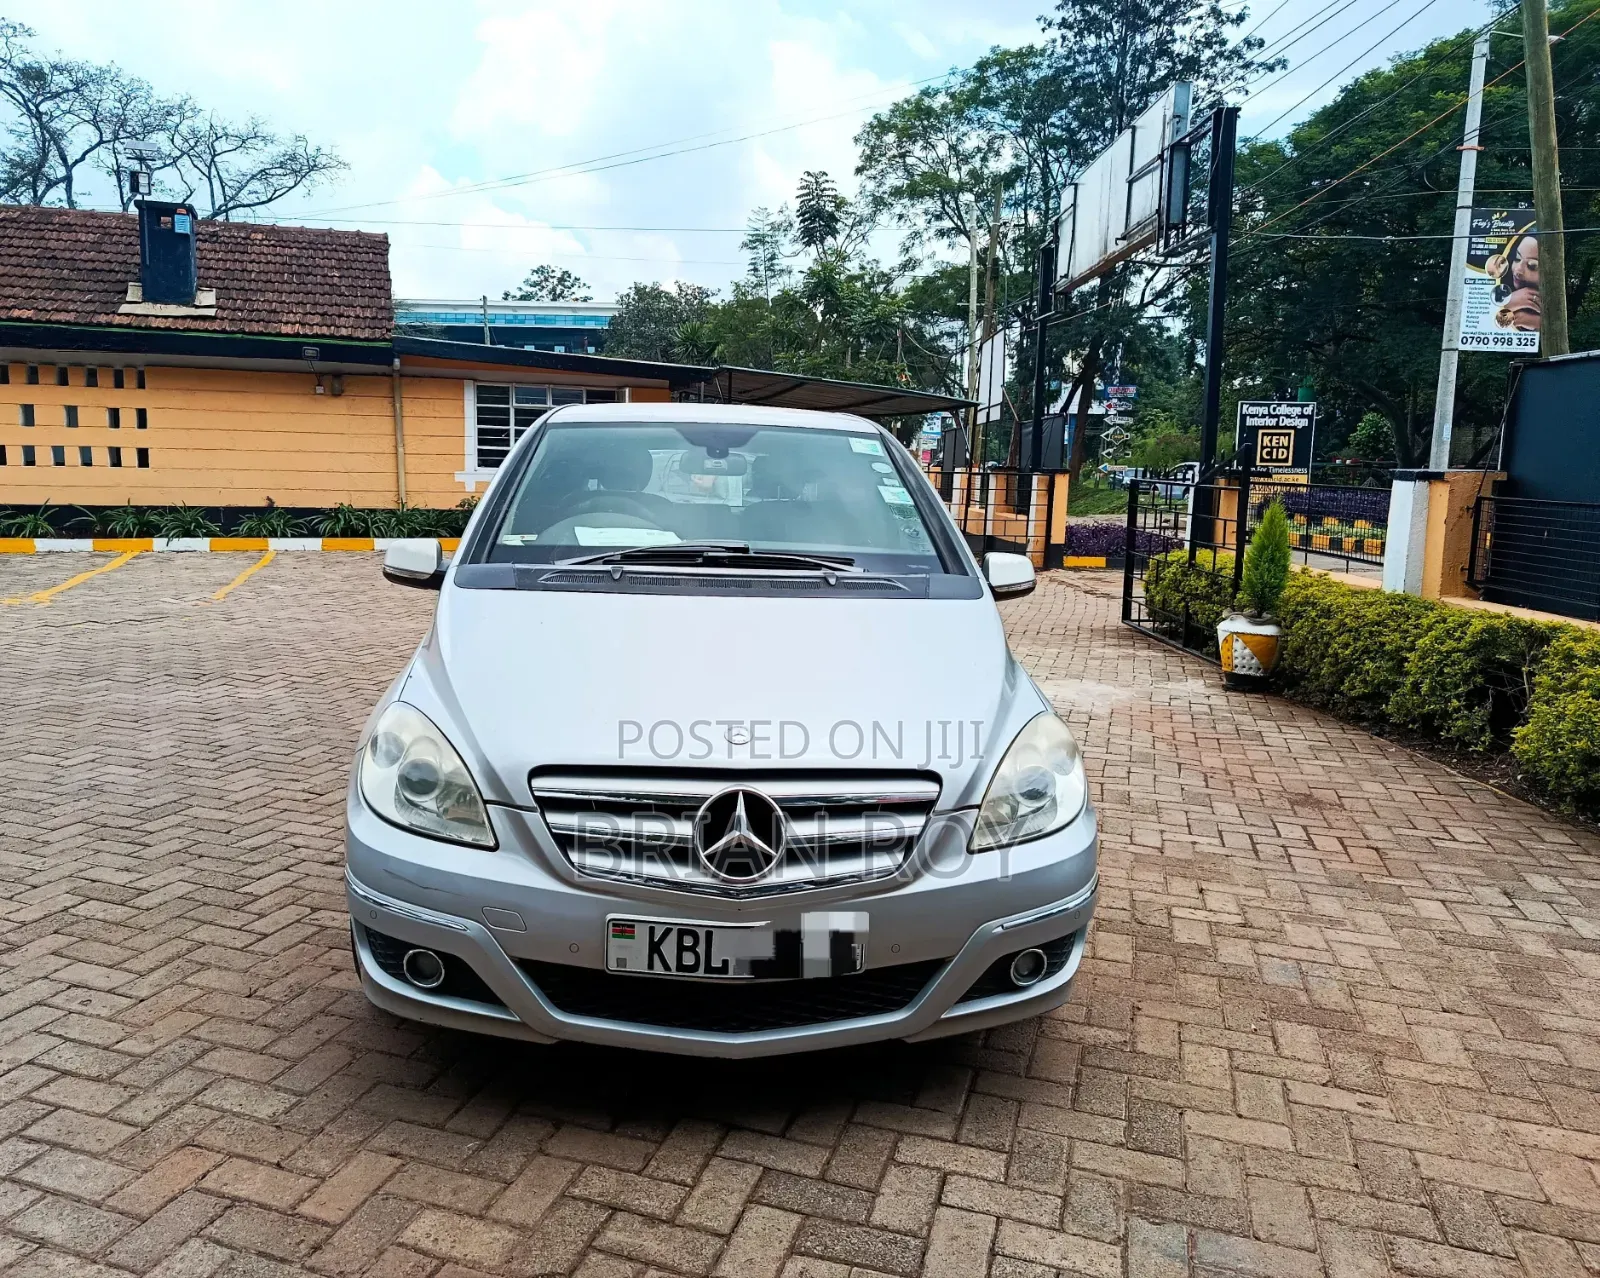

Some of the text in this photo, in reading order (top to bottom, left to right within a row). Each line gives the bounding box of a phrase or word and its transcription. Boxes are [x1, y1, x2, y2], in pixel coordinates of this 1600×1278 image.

[1491, 220, 1515, 229] Beauty
[1460, 336, 1536, 347] 0790 998 325
[1242, 404, 1314, 417] Kenya College of
[1246, 416, 1309, 429] Interior Design
[1262, 435, 1289, 447] KEN
[1261, 448, 1288, 459] CID
[1268, 466, 1308, 474] Timelessness
[647, 925, 729, 975] KBL
